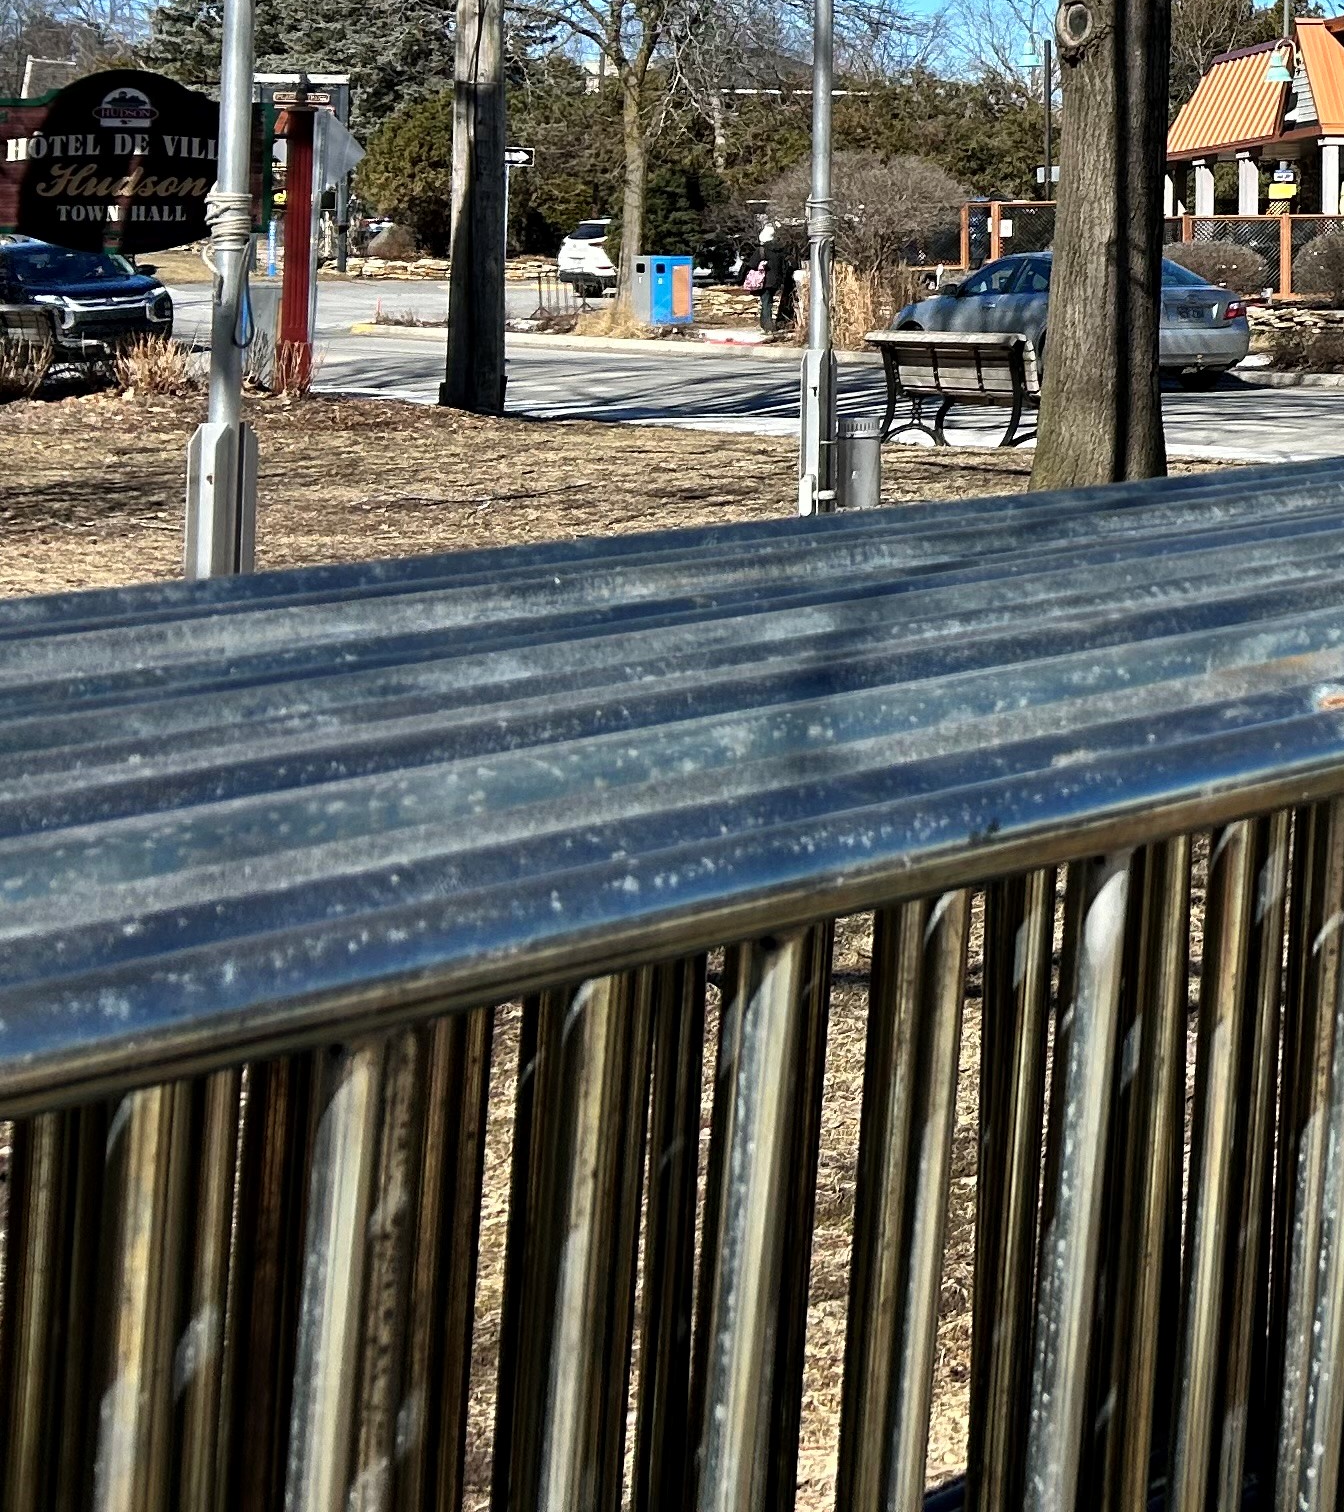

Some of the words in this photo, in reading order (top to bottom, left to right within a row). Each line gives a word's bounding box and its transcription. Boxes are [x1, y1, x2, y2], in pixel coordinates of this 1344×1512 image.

[100, 108, 151, 118] HUDSON
[6, 131, 101, 162] HÔTEL
[114, 133, 149, 156] DE
[162, 134, 219, 161] VILL
[36, 163, 208, 197] Hudson
[56, 204, 121, 223] TOWN
[130, 204, 187, 222] HALL
